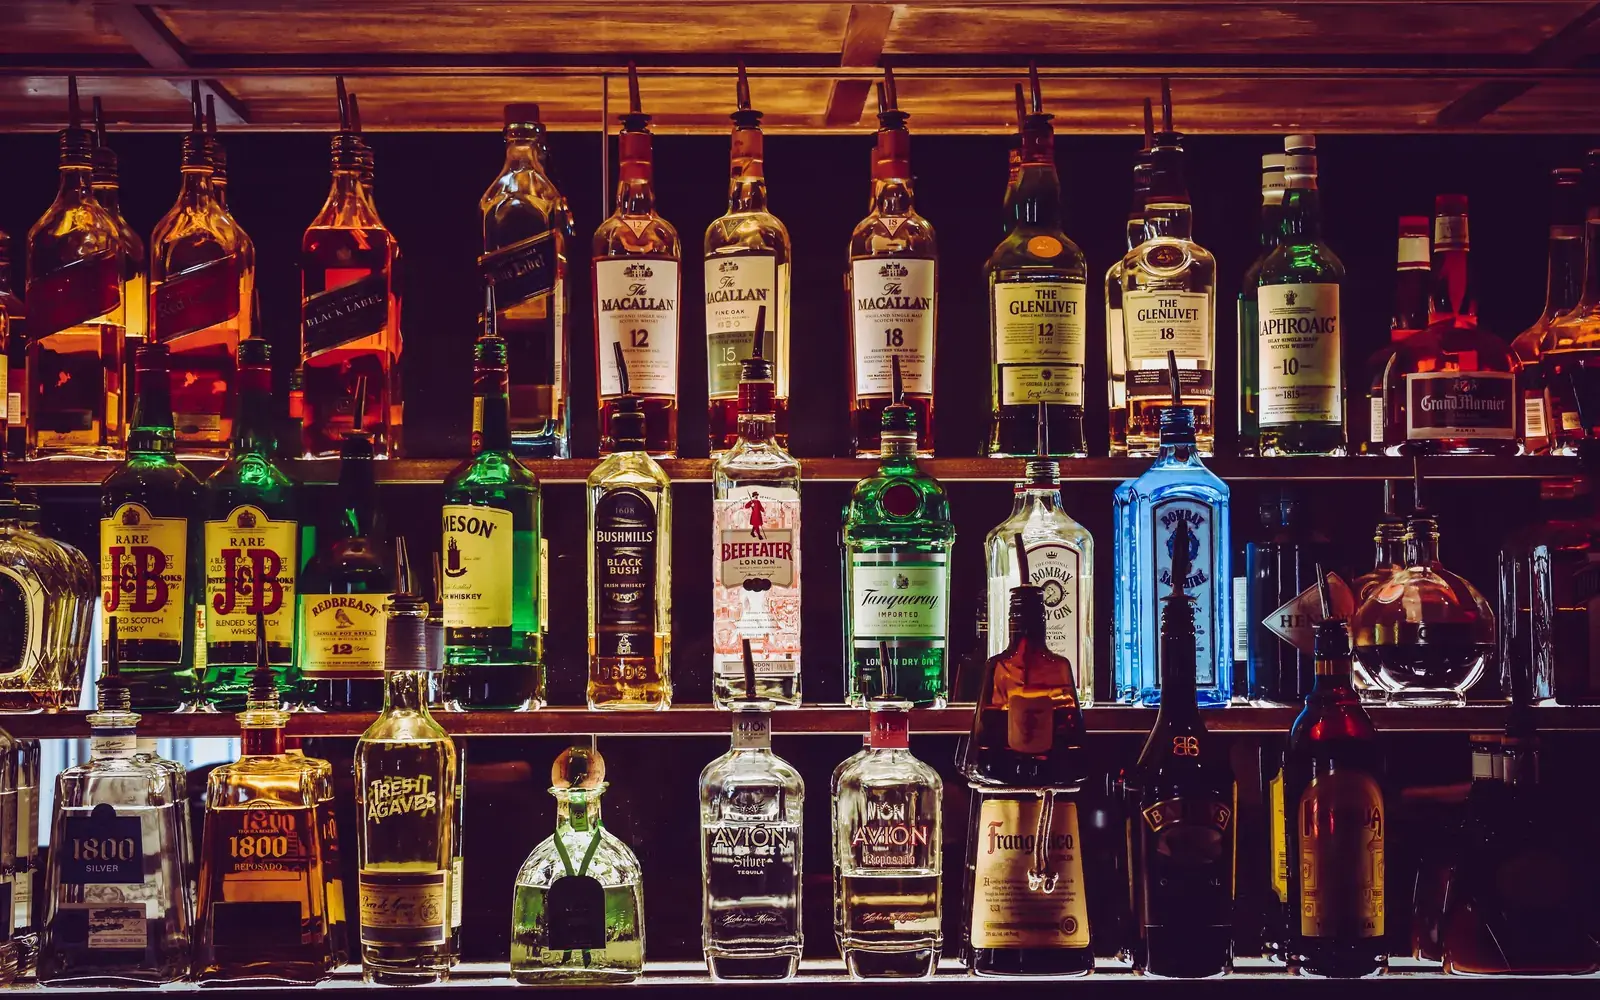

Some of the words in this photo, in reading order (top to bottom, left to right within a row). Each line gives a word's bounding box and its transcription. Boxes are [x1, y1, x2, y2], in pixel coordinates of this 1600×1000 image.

[626, 283, 648, 296] The
[719, 276, 736, 289] The
[881, 283, 902, 296] The
[1035, 290, 1057, 299] THE
[306, 309, 343, 327] BLACK
[346, 293, 382, 312] LABEL
[601, 298, 674, 311] MACALLAN
[858, 297, 931, 310] MACALLAN
[1009, 301, 1077, 315] GLENLIVET
[1137, 309, 1198, 321] GLENLIVET
[1038, 323, 1053, 336] 12
[1160, 328, 1174, 339] 18
[630, 329, 649, 347] 12
[885, 328, 904, 347] 18
[723, 347, 736, 361] 15
[1282, 357, 1299, 375] 10
[1284, 391, 1300, 399] 1815
[1420, 393, 1458, 412] Grand
[1458, 393, 1506, 411] Marnier
[615, 507, 635, 515] 1608
[1160, 509, 1205, 530] BOMBAY
[116, 535, 149, 544] RARE
[230, 537, 265, 546] RARE
[597, 531, 653, 542] BUSHMILLS
[721, 542, 793, 562] BEEFEATER
[103, 546, 169, 613] J&B
[213, 549, 284, 616] J&B
[1031, 567, 1073, 584] BOMBAY
[1160, 569, 1209, 588] SAIRE
[861, 589, 939, 610] Tanqueray
[312, 597, 379, 617] REDBREAST
[1054, 604, 1072, 620] GIN
[247, 619, 279, 627] SCTCH
[332, 644, 353, 655] 12
[866, 658, 899, 666] LONN
[902, 658, 918, 666] DRY
[921, 658, 934, 666] GIN
[368, 791, 436, 824] AGAVES
[712, 823, 788, 847] AVIÓN
[852, 823, 927, 846] AVIÓN
[987, 821, 1073, 854] Frangico
[72, 838, 134, 861] 1800
[230, 835, 287, 858] 1800
[234, 863, 283, 871] REPOSADO
[733, 855, 766, 868] Silver
[864, 853, 915, 867] Reposado
[86, 864, 119, 872] SILVER
